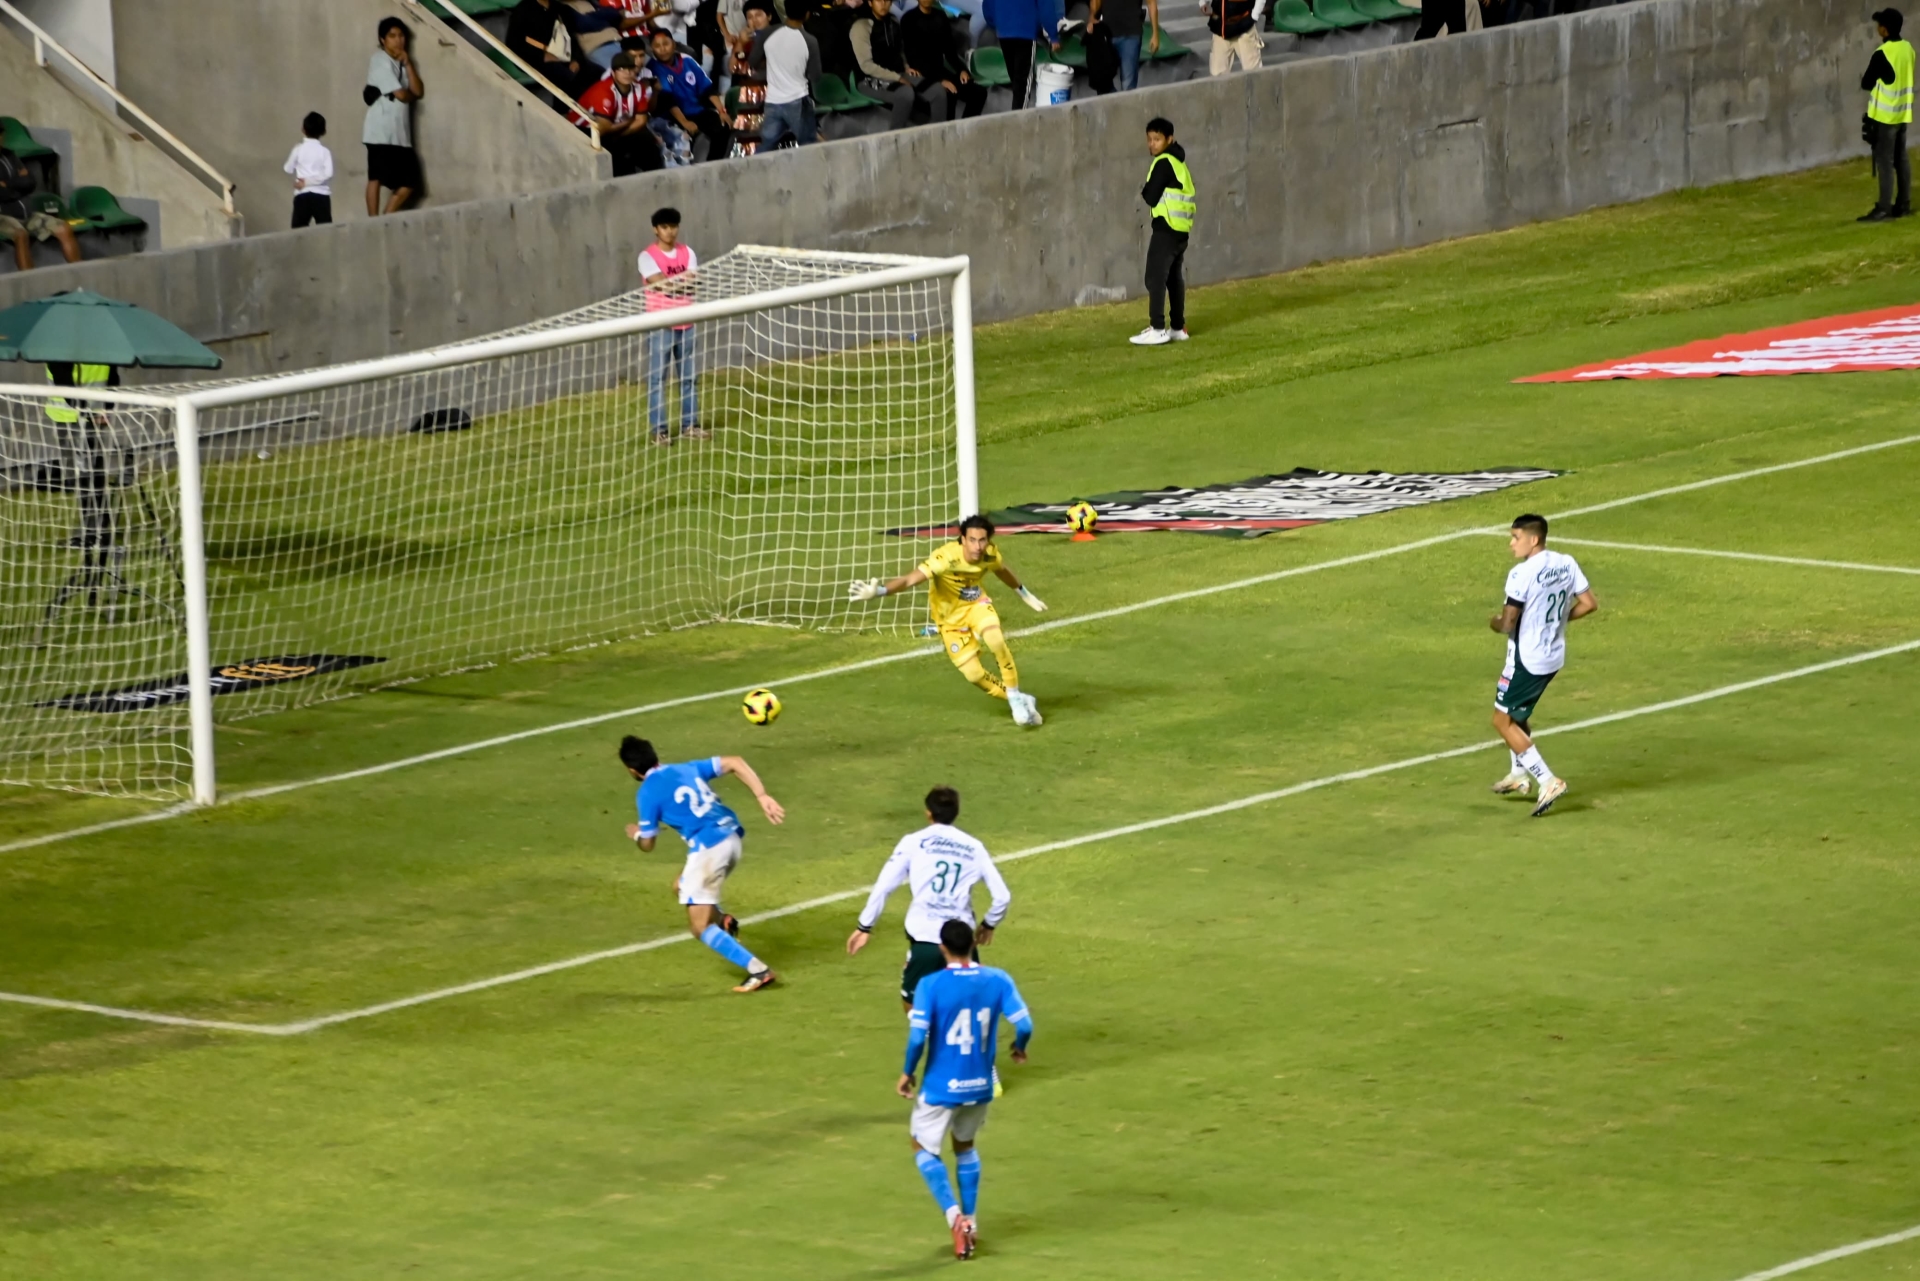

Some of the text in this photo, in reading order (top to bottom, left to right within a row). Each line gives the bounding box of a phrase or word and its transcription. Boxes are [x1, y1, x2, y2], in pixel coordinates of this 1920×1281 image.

[674, 777, 718, 818] 24
[931, 860, 962, 896] 31
[945, 1007, 992, 1055] 41
